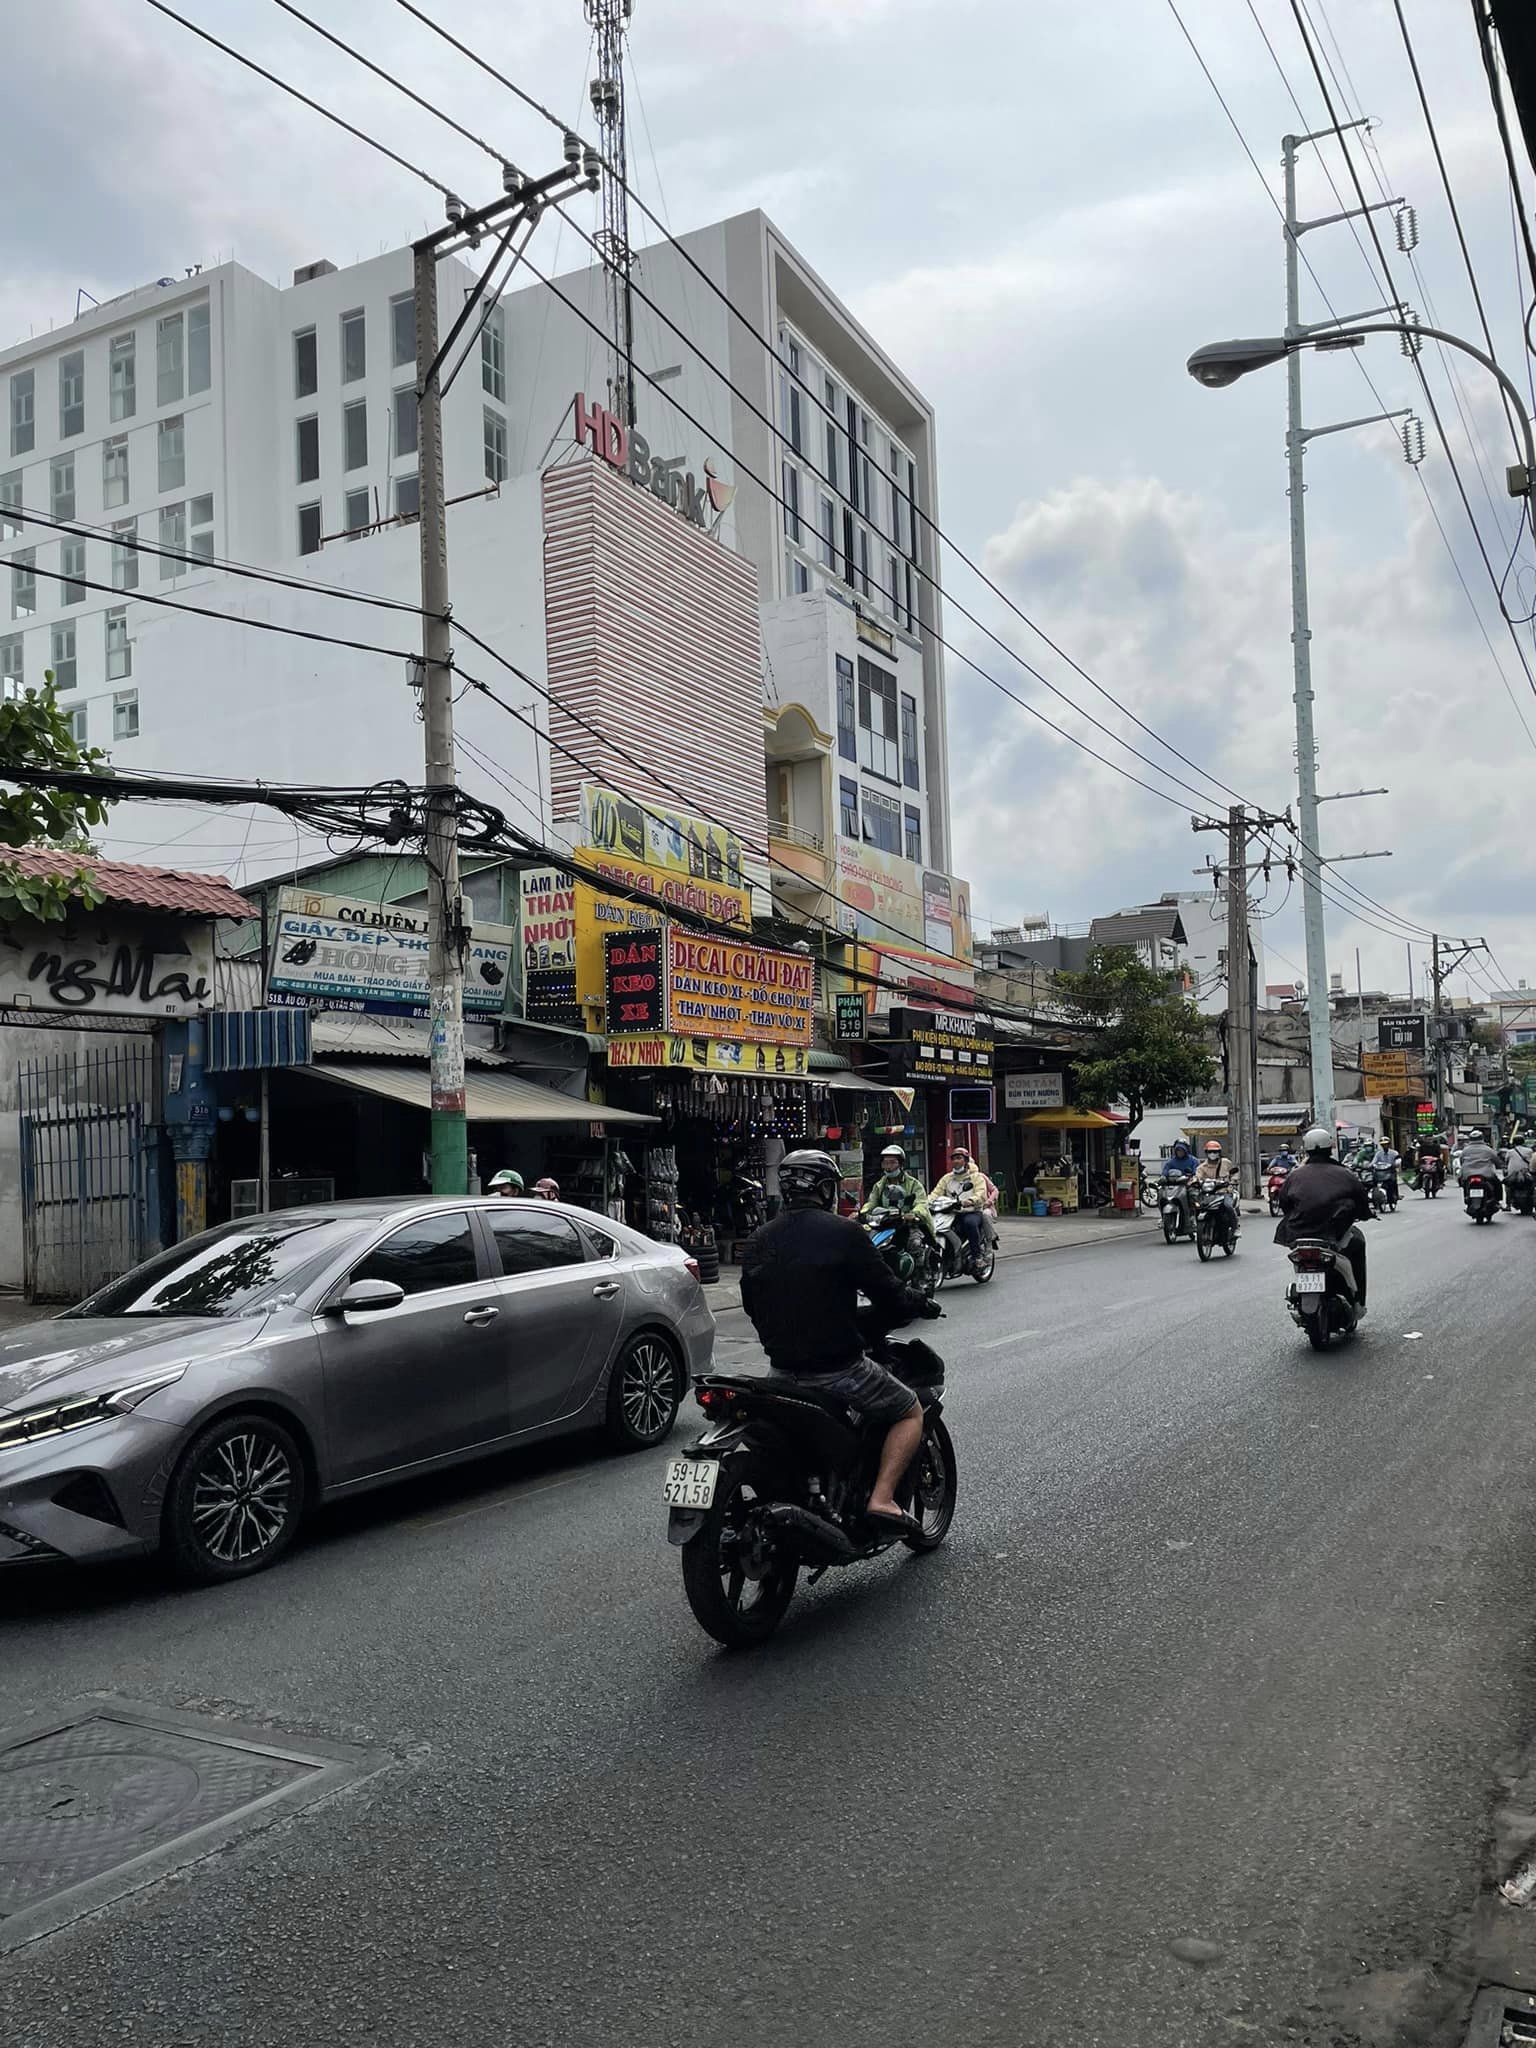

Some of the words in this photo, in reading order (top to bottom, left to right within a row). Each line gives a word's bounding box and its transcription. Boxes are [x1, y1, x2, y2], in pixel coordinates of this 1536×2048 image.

[575, 392, 706, 528] HDBank
[523, 874, 552, 894] LÀM
[610, 942, 657, 965] DÁN
[672, 940, 730, 977] DECAL
[731, 951, 779, 986] CHÂU
[313, 971, 336, 981] MUA
[363, 976, 385, 987] TRAO
[612, 974, 656, 993] KEO
[703, 980, 729, 997] KEO
[798, 995, 812, 1010] XE
[838, 995, 862, 1007] PHÂN
[621, 1002, 650, 1021] XE
[677, 1000, 708, 1018] THAY
[750, 1010, 777, 1028] THAY
[793, 1016, 808, 1031] XE
[841, 1006, 860, 1018] BÓN
[840, 1019, 861, 1031] 518
[935, 1014, 976, 1036] MR.KHANG
[609, 1041, 638, 1067] THAY
[672, 1463, 710, 1482] 59-L2
[663, 1483, 711, 1505] 521.58
